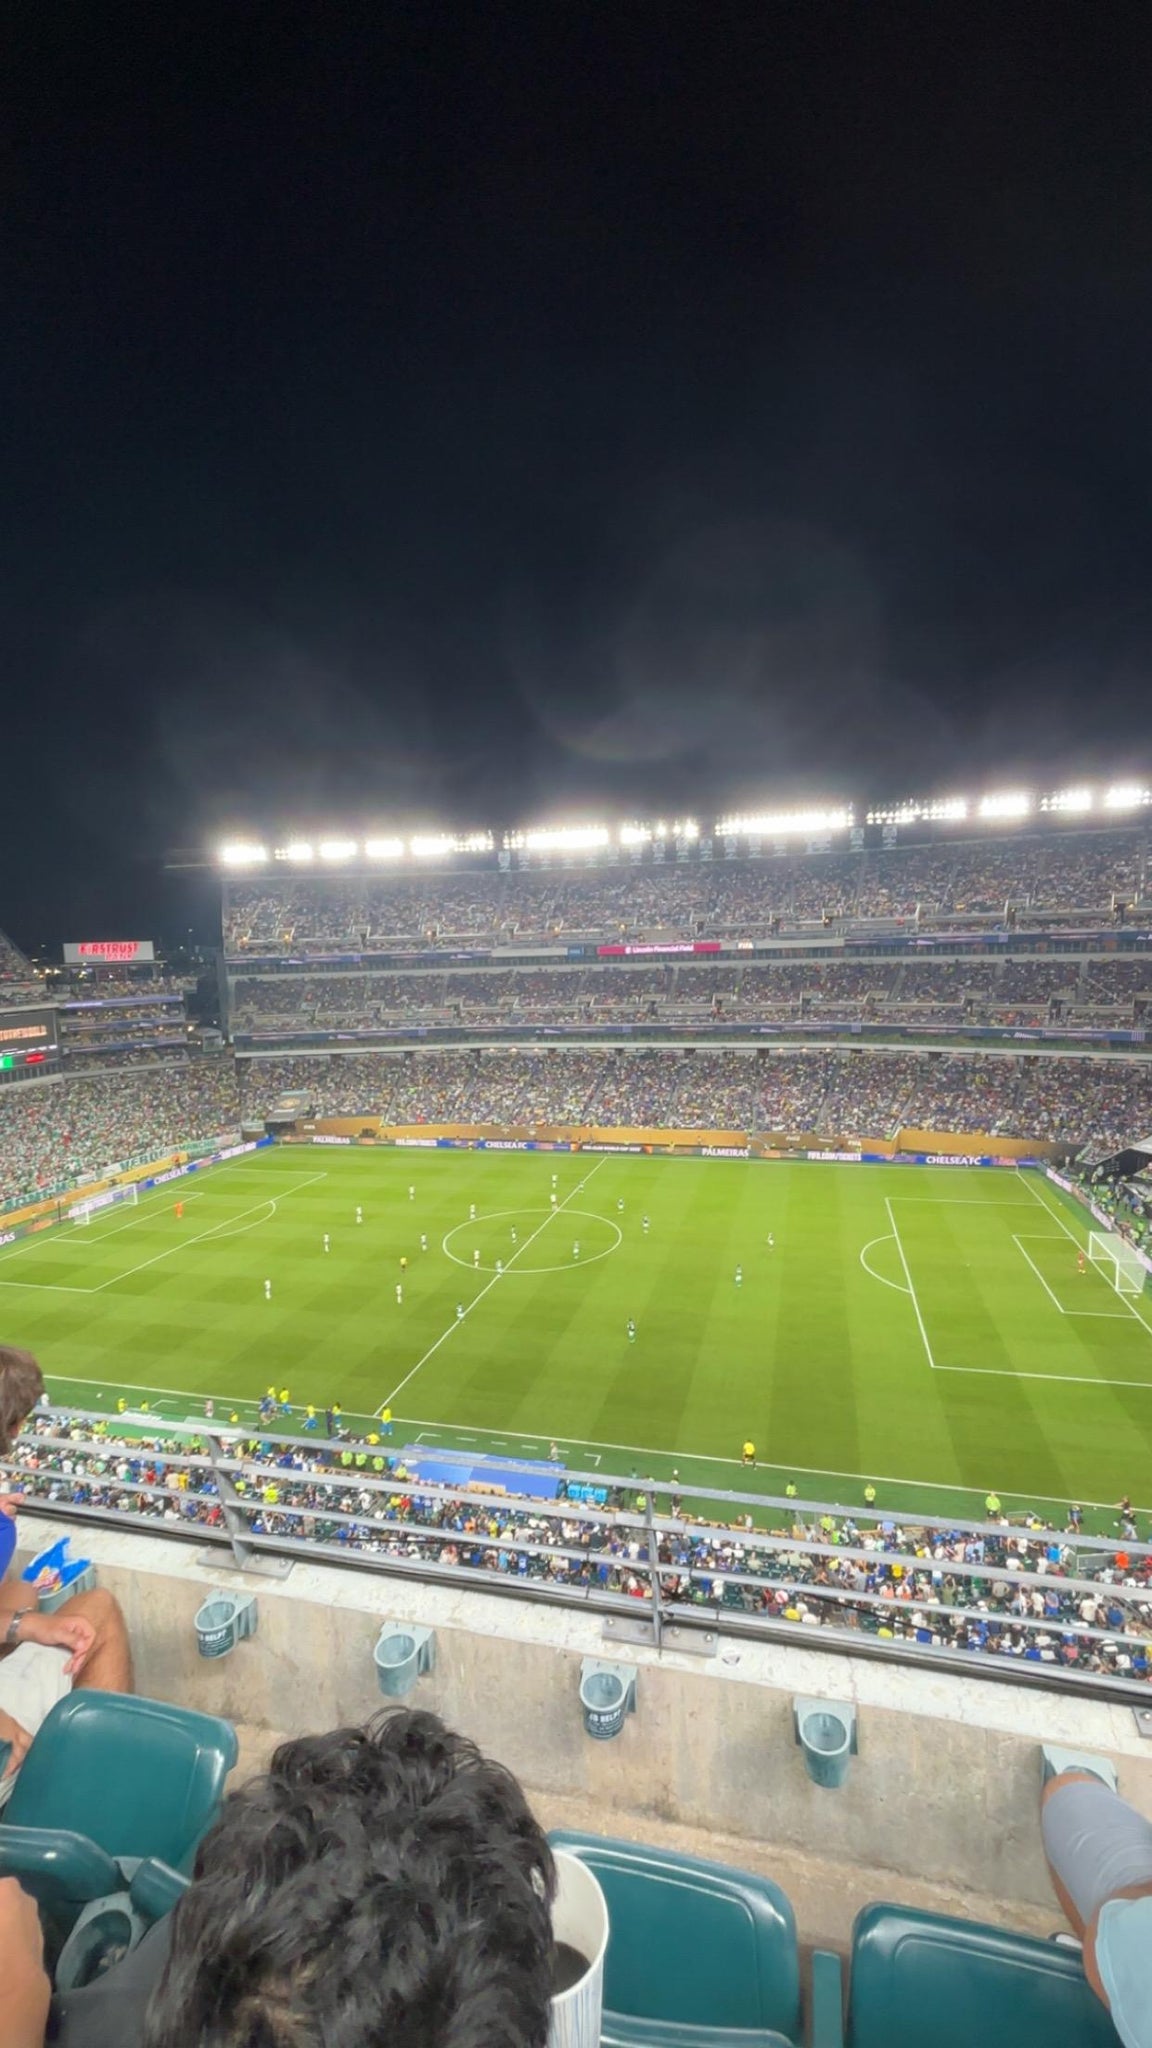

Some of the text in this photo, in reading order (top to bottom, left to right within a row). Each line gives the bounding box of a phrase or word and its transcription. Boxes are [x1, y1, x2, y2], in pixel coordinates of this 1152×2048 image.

[485, 1140, 517, 1149] CHELSEA
[702, 1147, 749, 1158] PALMEIRAS
[926, 1155, 982, 1166] CHELSEA FC
